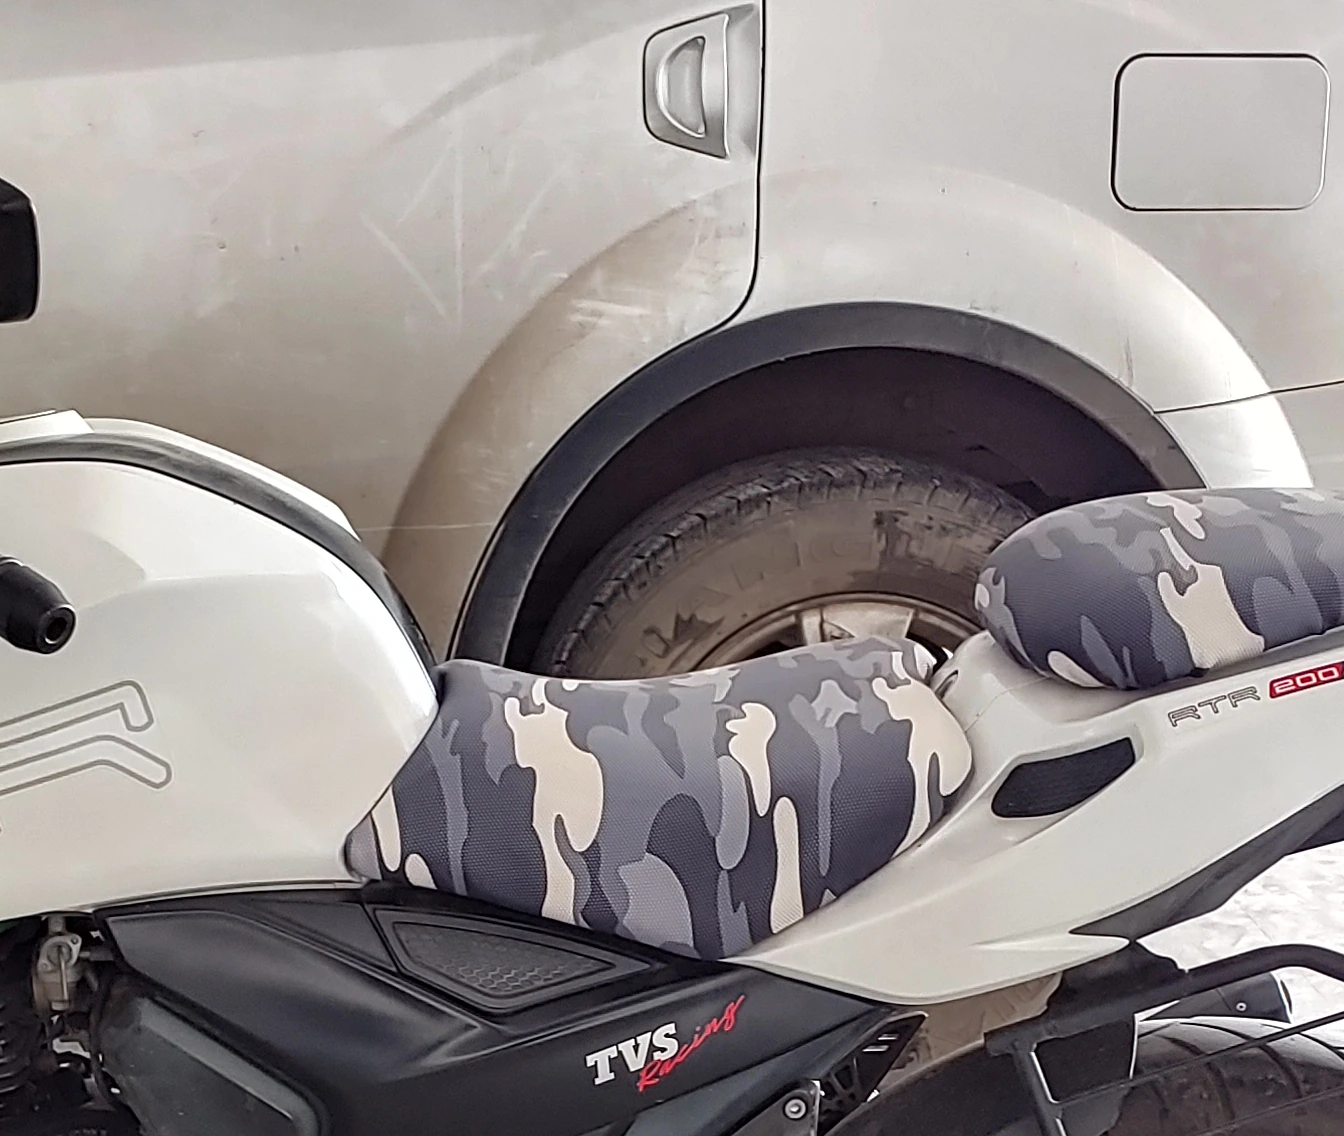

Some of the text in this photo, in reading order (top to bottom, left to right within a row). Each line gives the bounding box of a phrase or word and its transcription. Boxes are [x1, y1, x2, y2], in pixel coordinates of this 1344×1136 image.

[1167, 686, 1261, 728] RTR
[585, 1022, 680, 1086] TVS
[637, 994, 746, 1092] Racing
